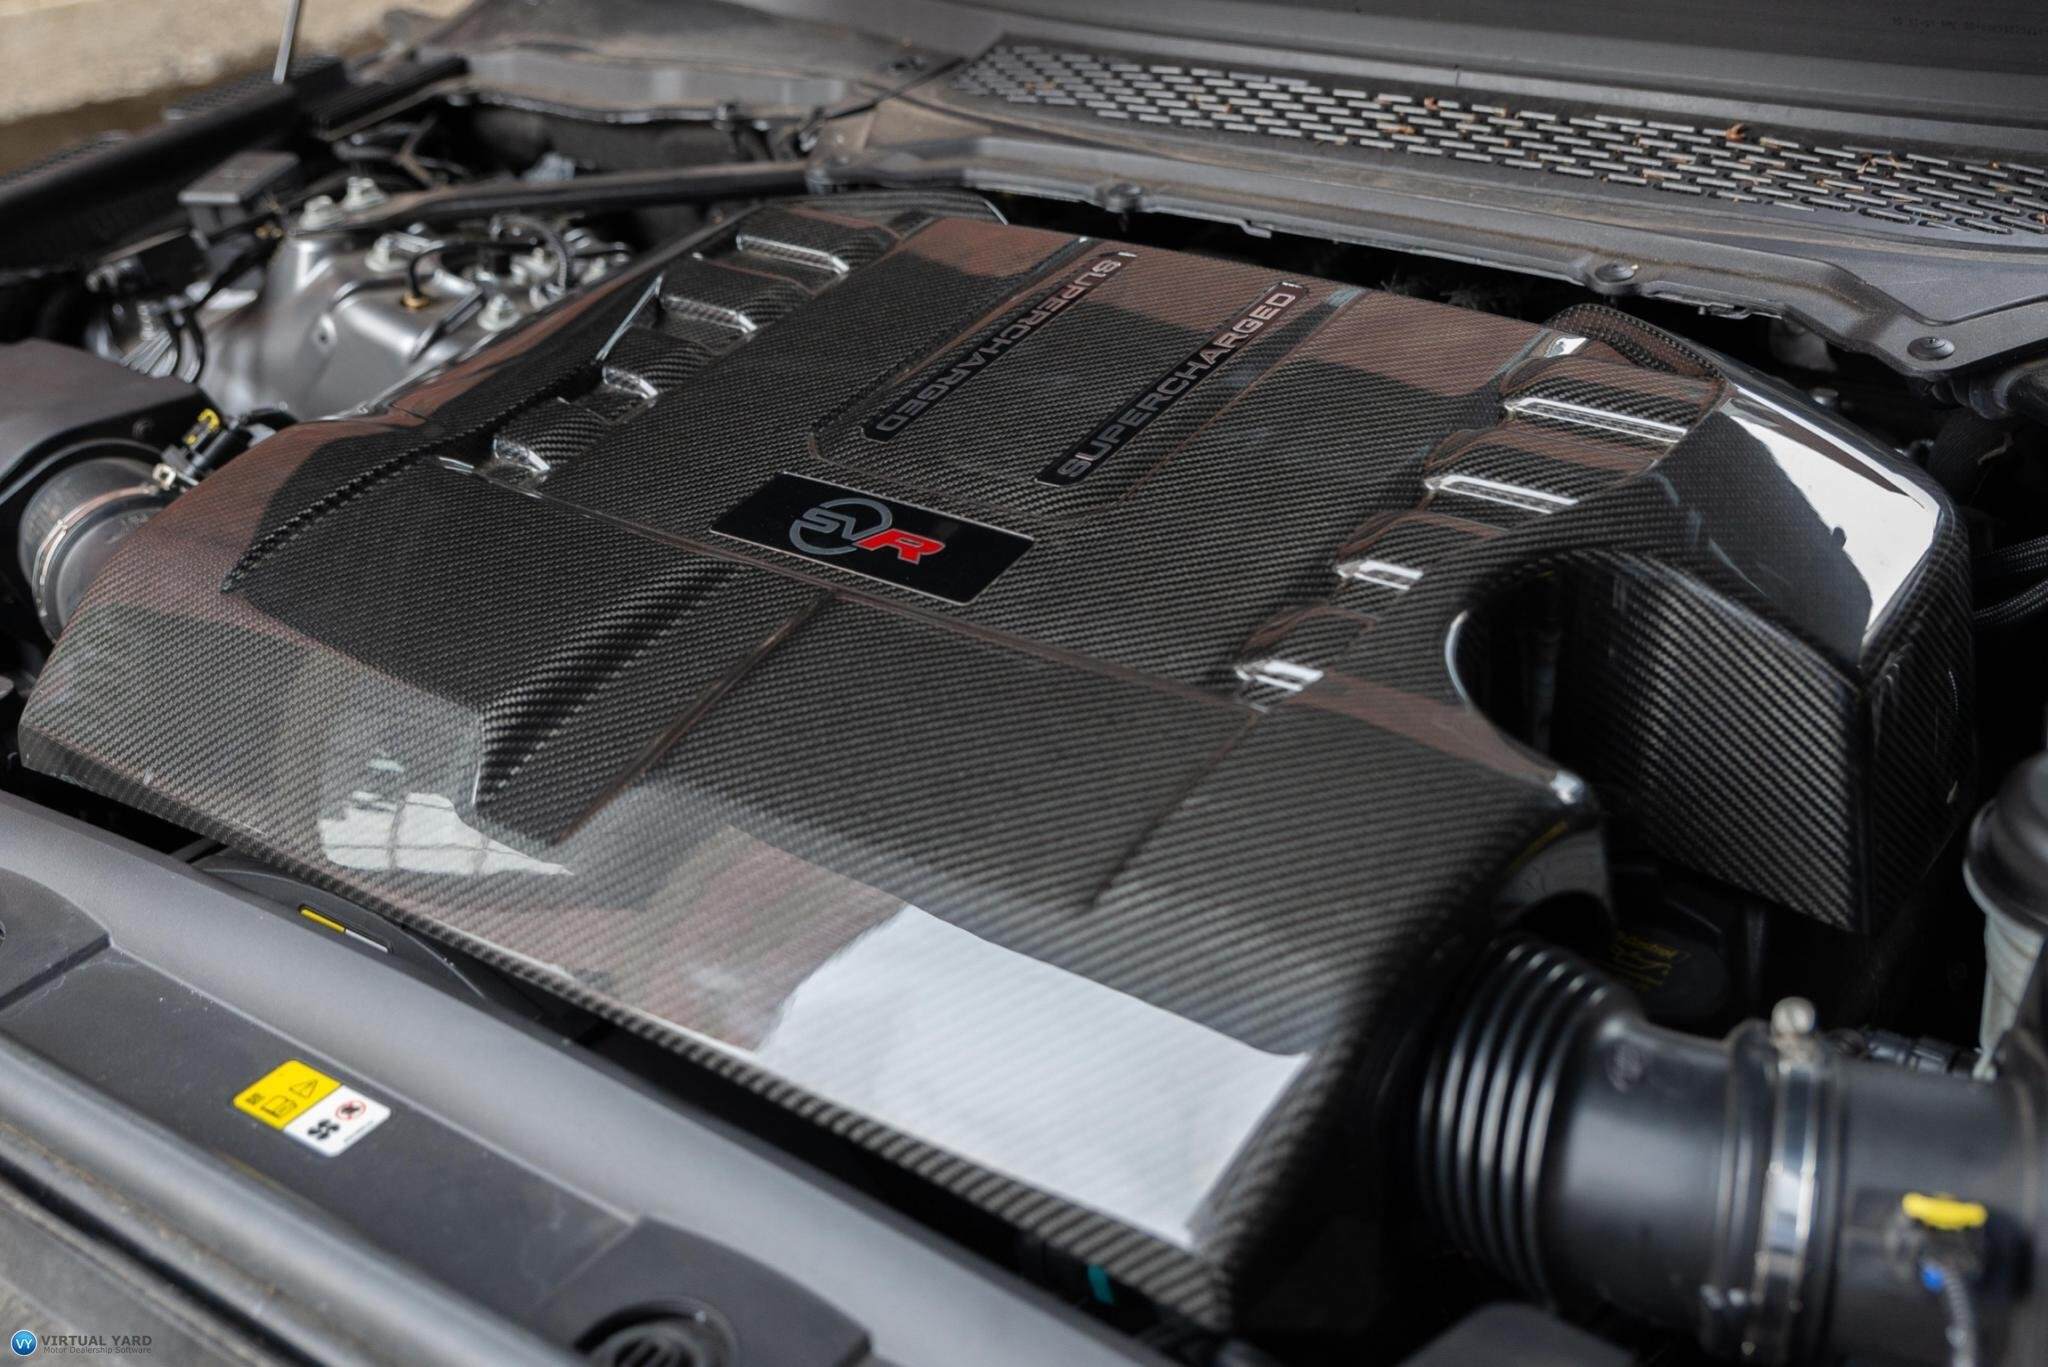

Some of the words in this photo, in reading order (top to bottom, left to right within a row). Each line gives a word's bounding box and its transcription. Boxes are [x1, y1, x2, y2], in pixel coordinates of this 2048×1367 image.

[876, 258, 1122, 433] SUPERCHARGED
[1057, 290, 1296, 479] SUPERCHARGED
[789, 498, 945, 565] SVR
